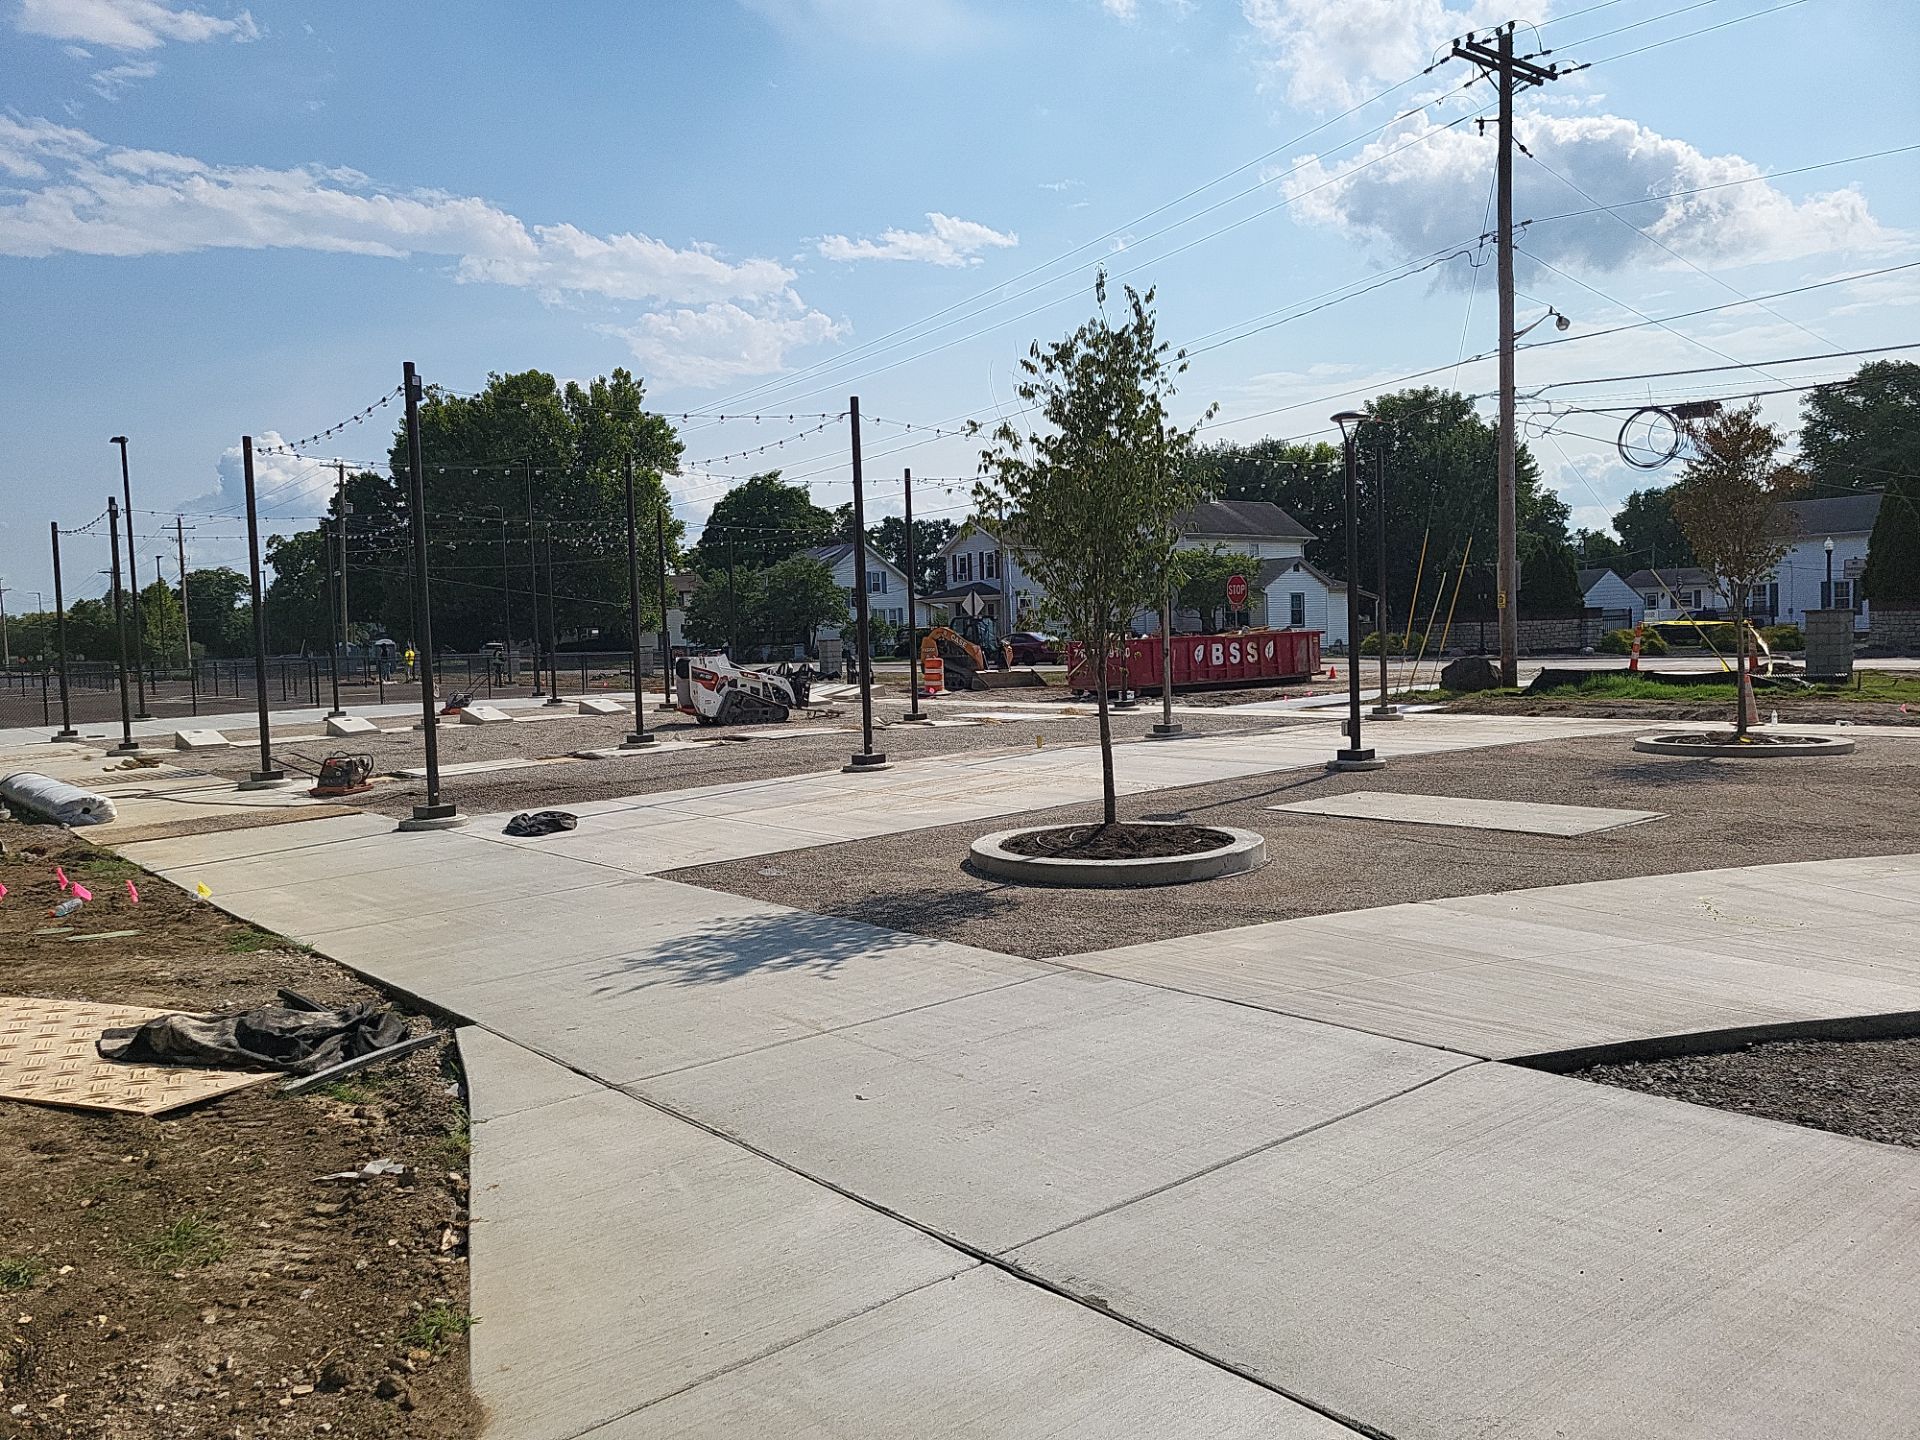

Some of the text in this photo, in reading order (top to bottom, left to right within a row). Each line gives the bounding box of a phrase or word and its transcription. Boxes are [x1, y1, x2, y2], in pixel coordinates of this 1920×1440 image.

[1228, 584, 1245, 595] STOP
[950, 634, 968, 649] CASE
[1211, 641, 1258, 665] BSS
